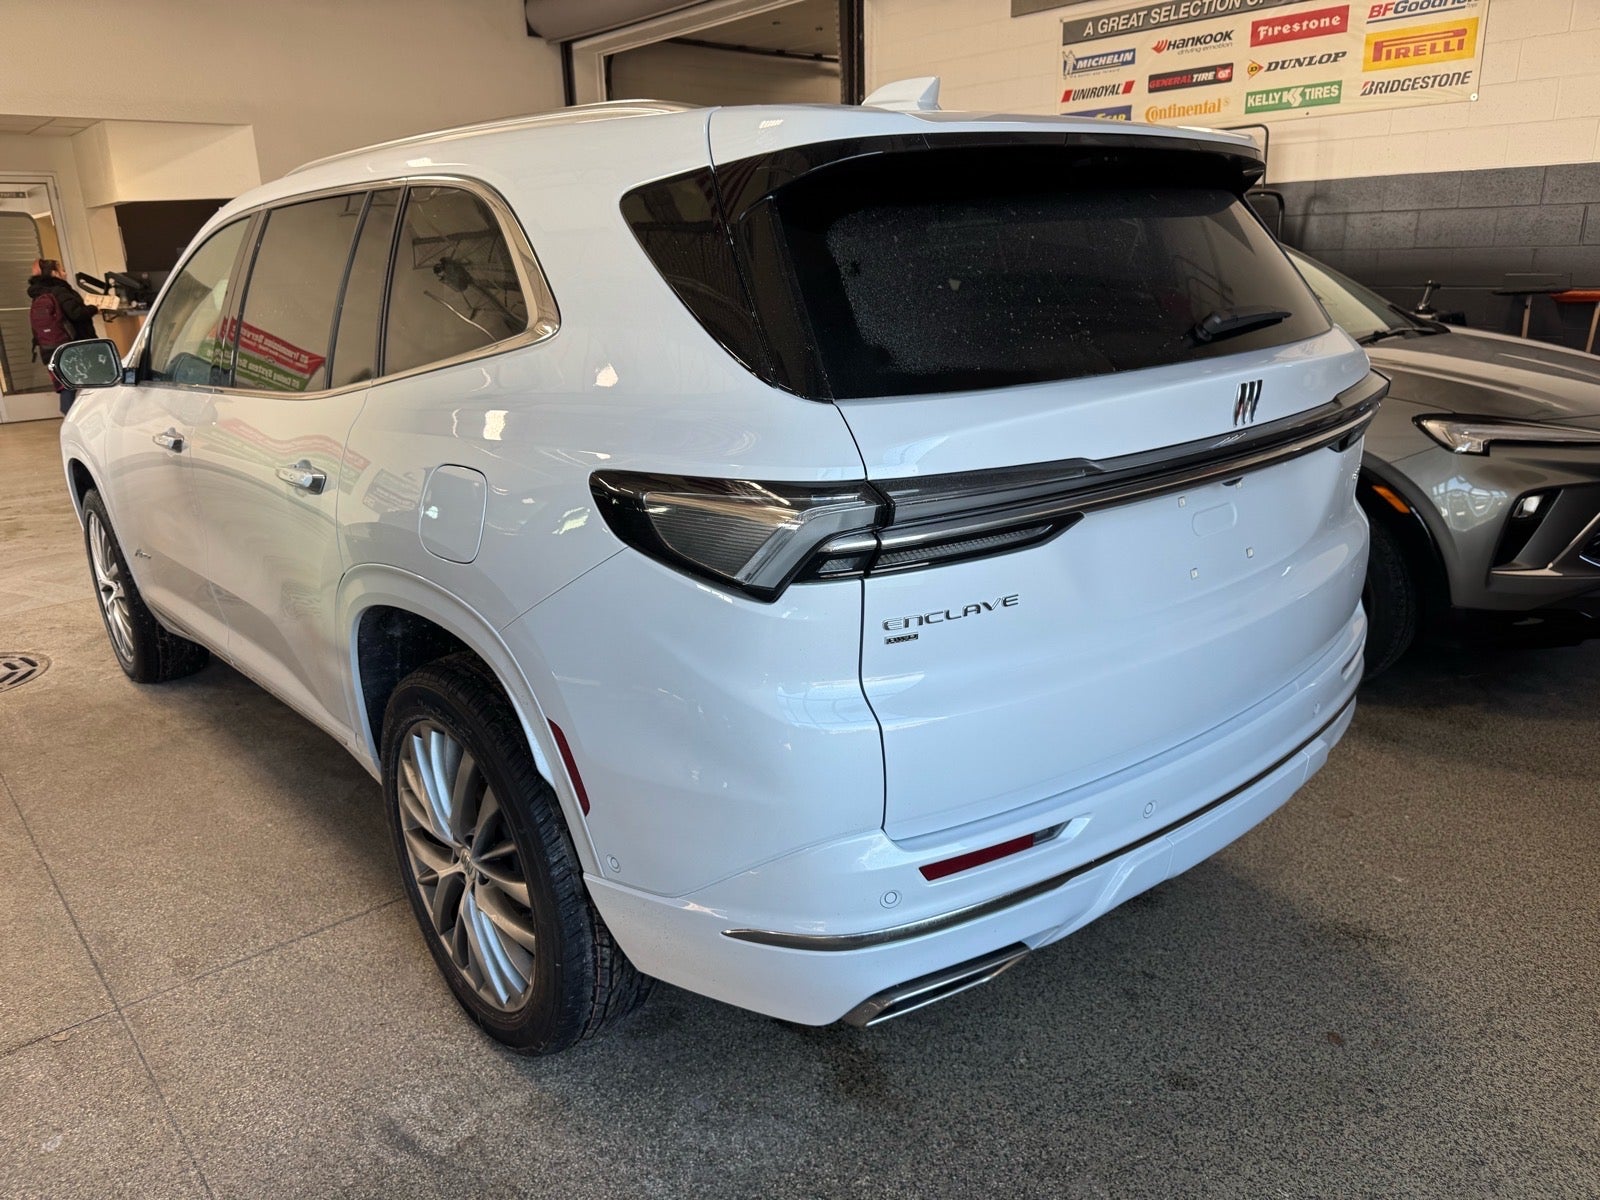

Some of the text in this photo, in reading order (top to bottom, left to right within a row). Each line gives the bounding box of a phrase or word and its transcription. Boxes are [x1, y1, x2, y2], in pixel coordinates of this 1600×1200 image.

[1083, 0, 1242, 37] A GREAT SELECTION
[1257, 15, 1342, 41] Firestone
[1372, 28, 1468, 62] PIRELLI
[1076, 52, 1134, 69] MICHELIN
[1264, 51, 1348, 73] DUNLOP
[1072, 83, 1121, 102] UNIROYAL
[1359, 70, 1473, 97] BRIDGESTONE
[1247, 91, 1282, 108] KELLY
[1304, 85, 1340, 101] TIRES
[1144, 98, 1222, 123] Continental
[881, 593, 1019, 631] ENCLAVE
